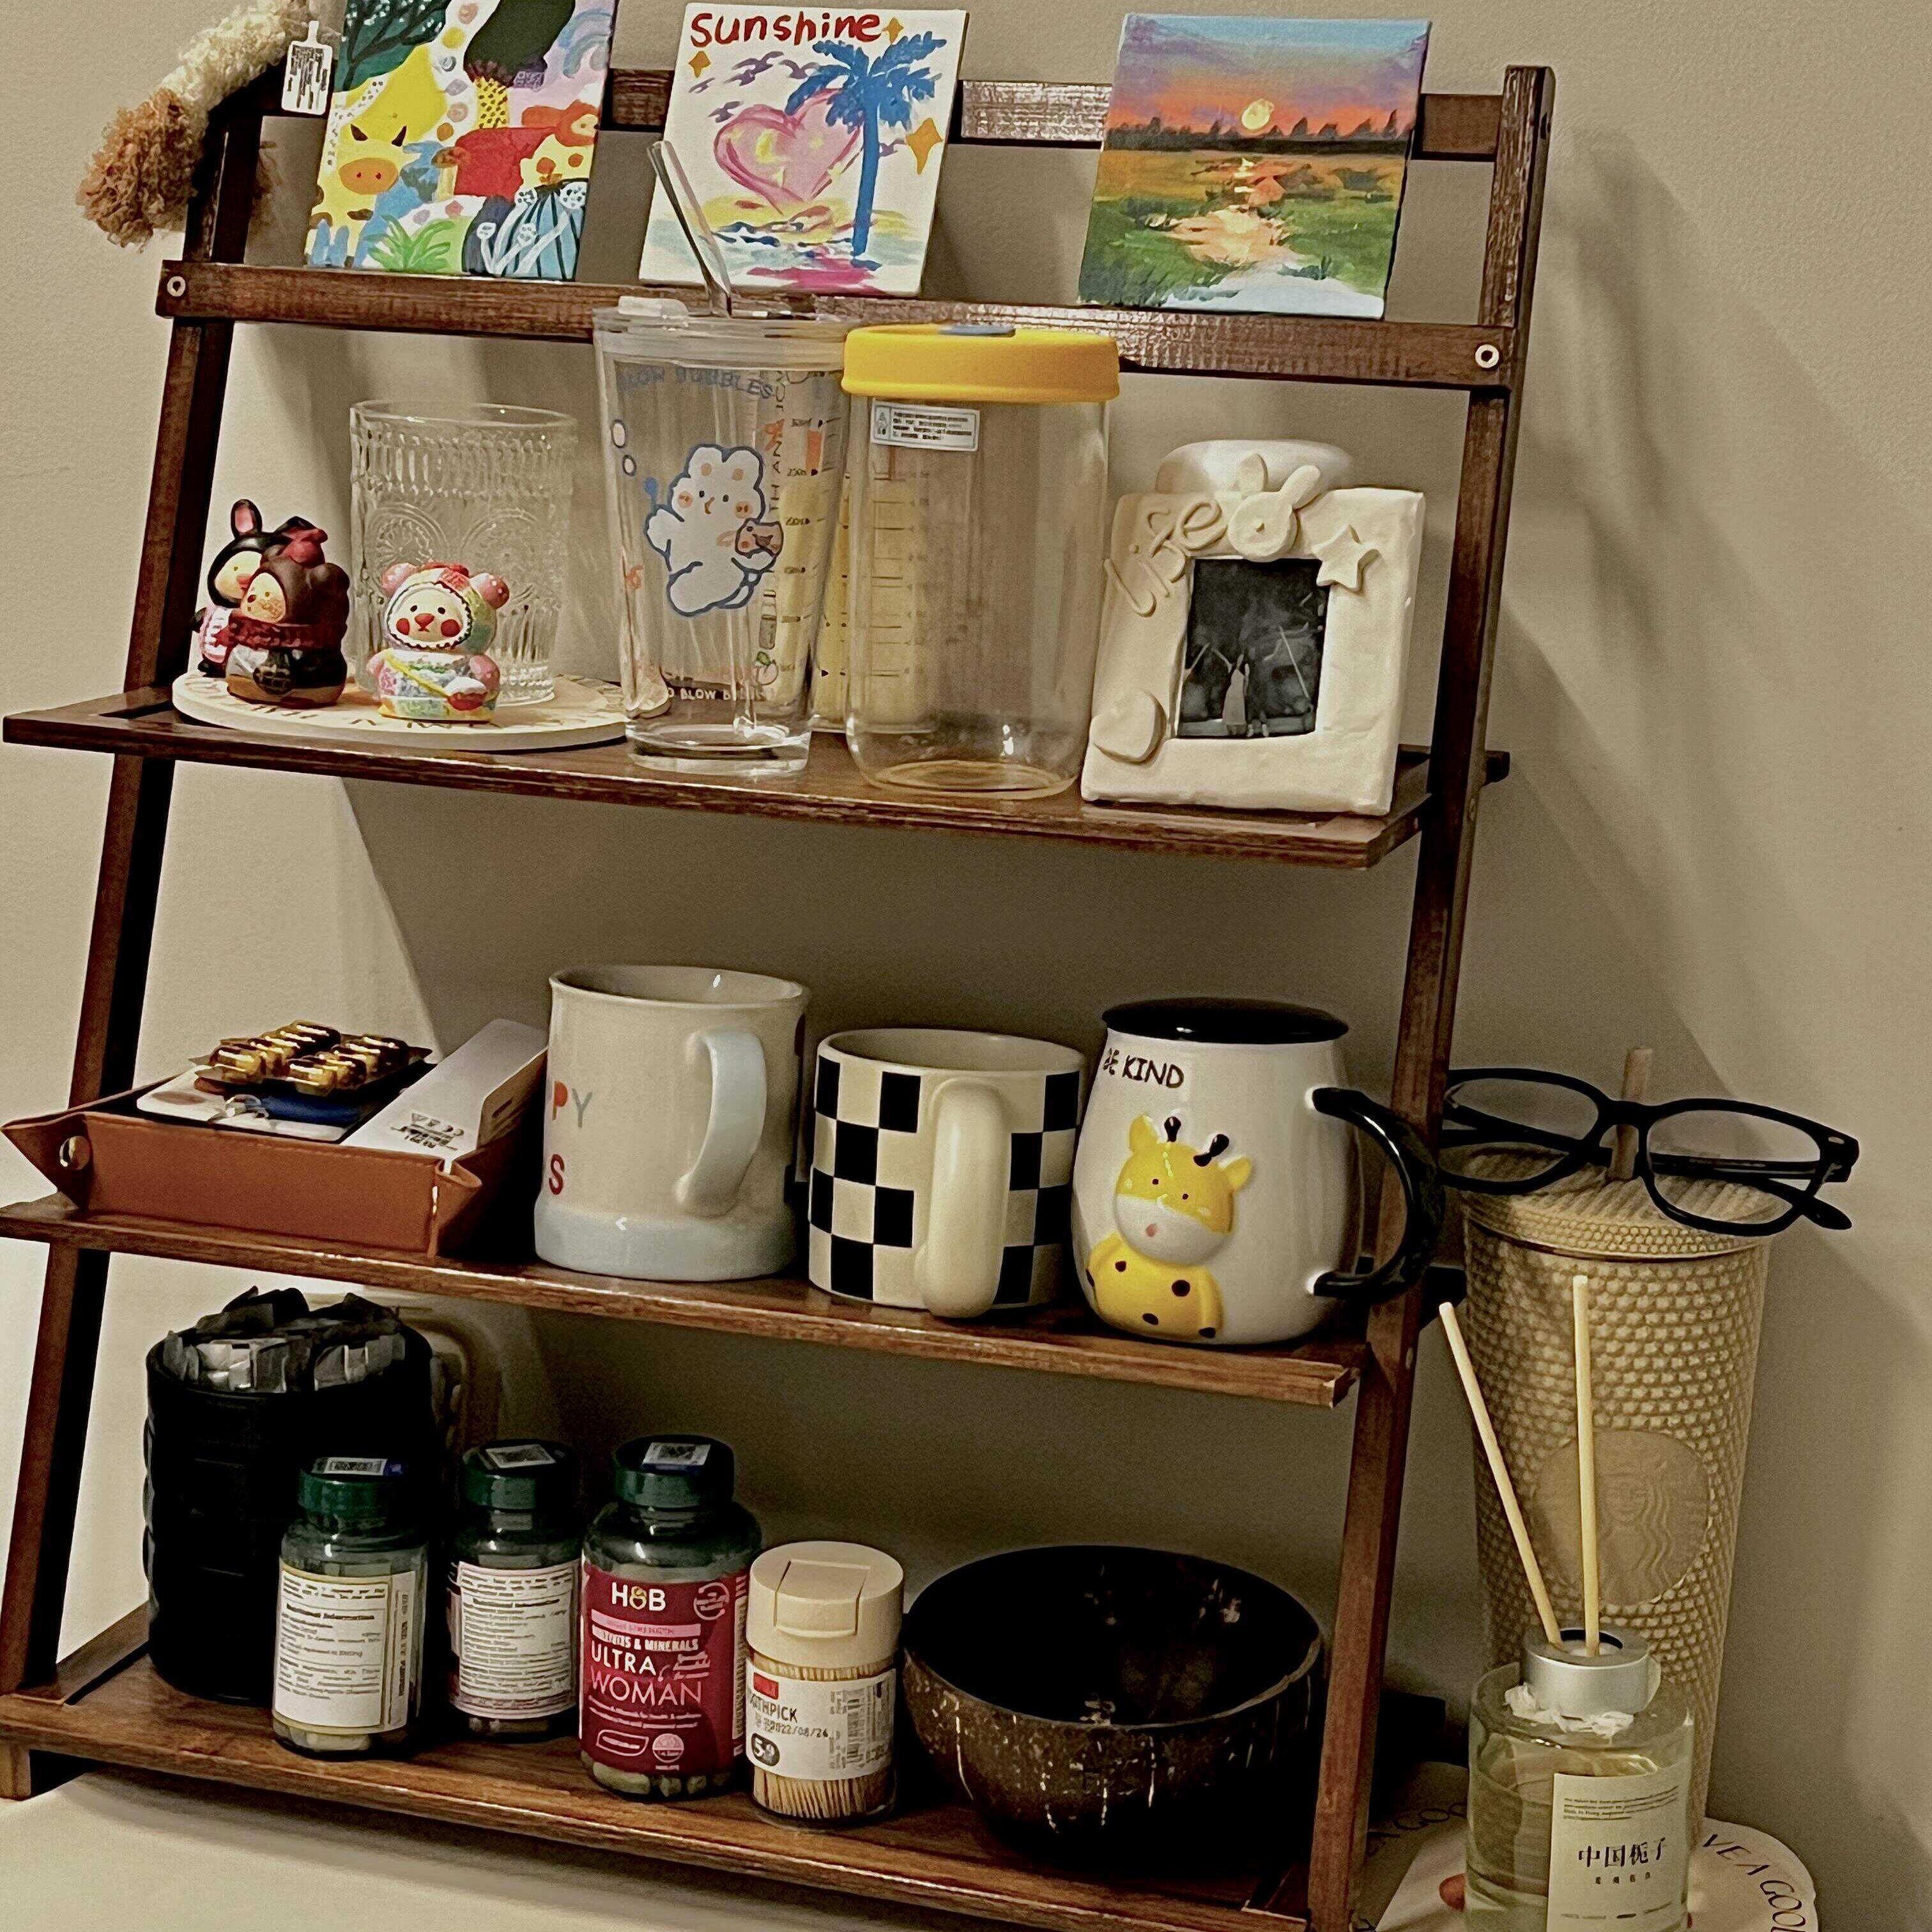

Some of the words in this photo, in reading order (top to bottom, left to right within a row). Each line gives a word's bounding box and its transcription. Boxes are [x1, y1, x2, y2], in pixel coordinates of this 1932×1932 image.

[691, 11, 882, 47] Sunshine
[1122, 1054, 1184, 1089] KIND
[611, 1581, 667, 1612] H&B
[591, 1639, 657, 1676] ULTRA
[590, 1665, 702, 1706] WOMAN
[1759, 1879, 1807, 1932] GOO
